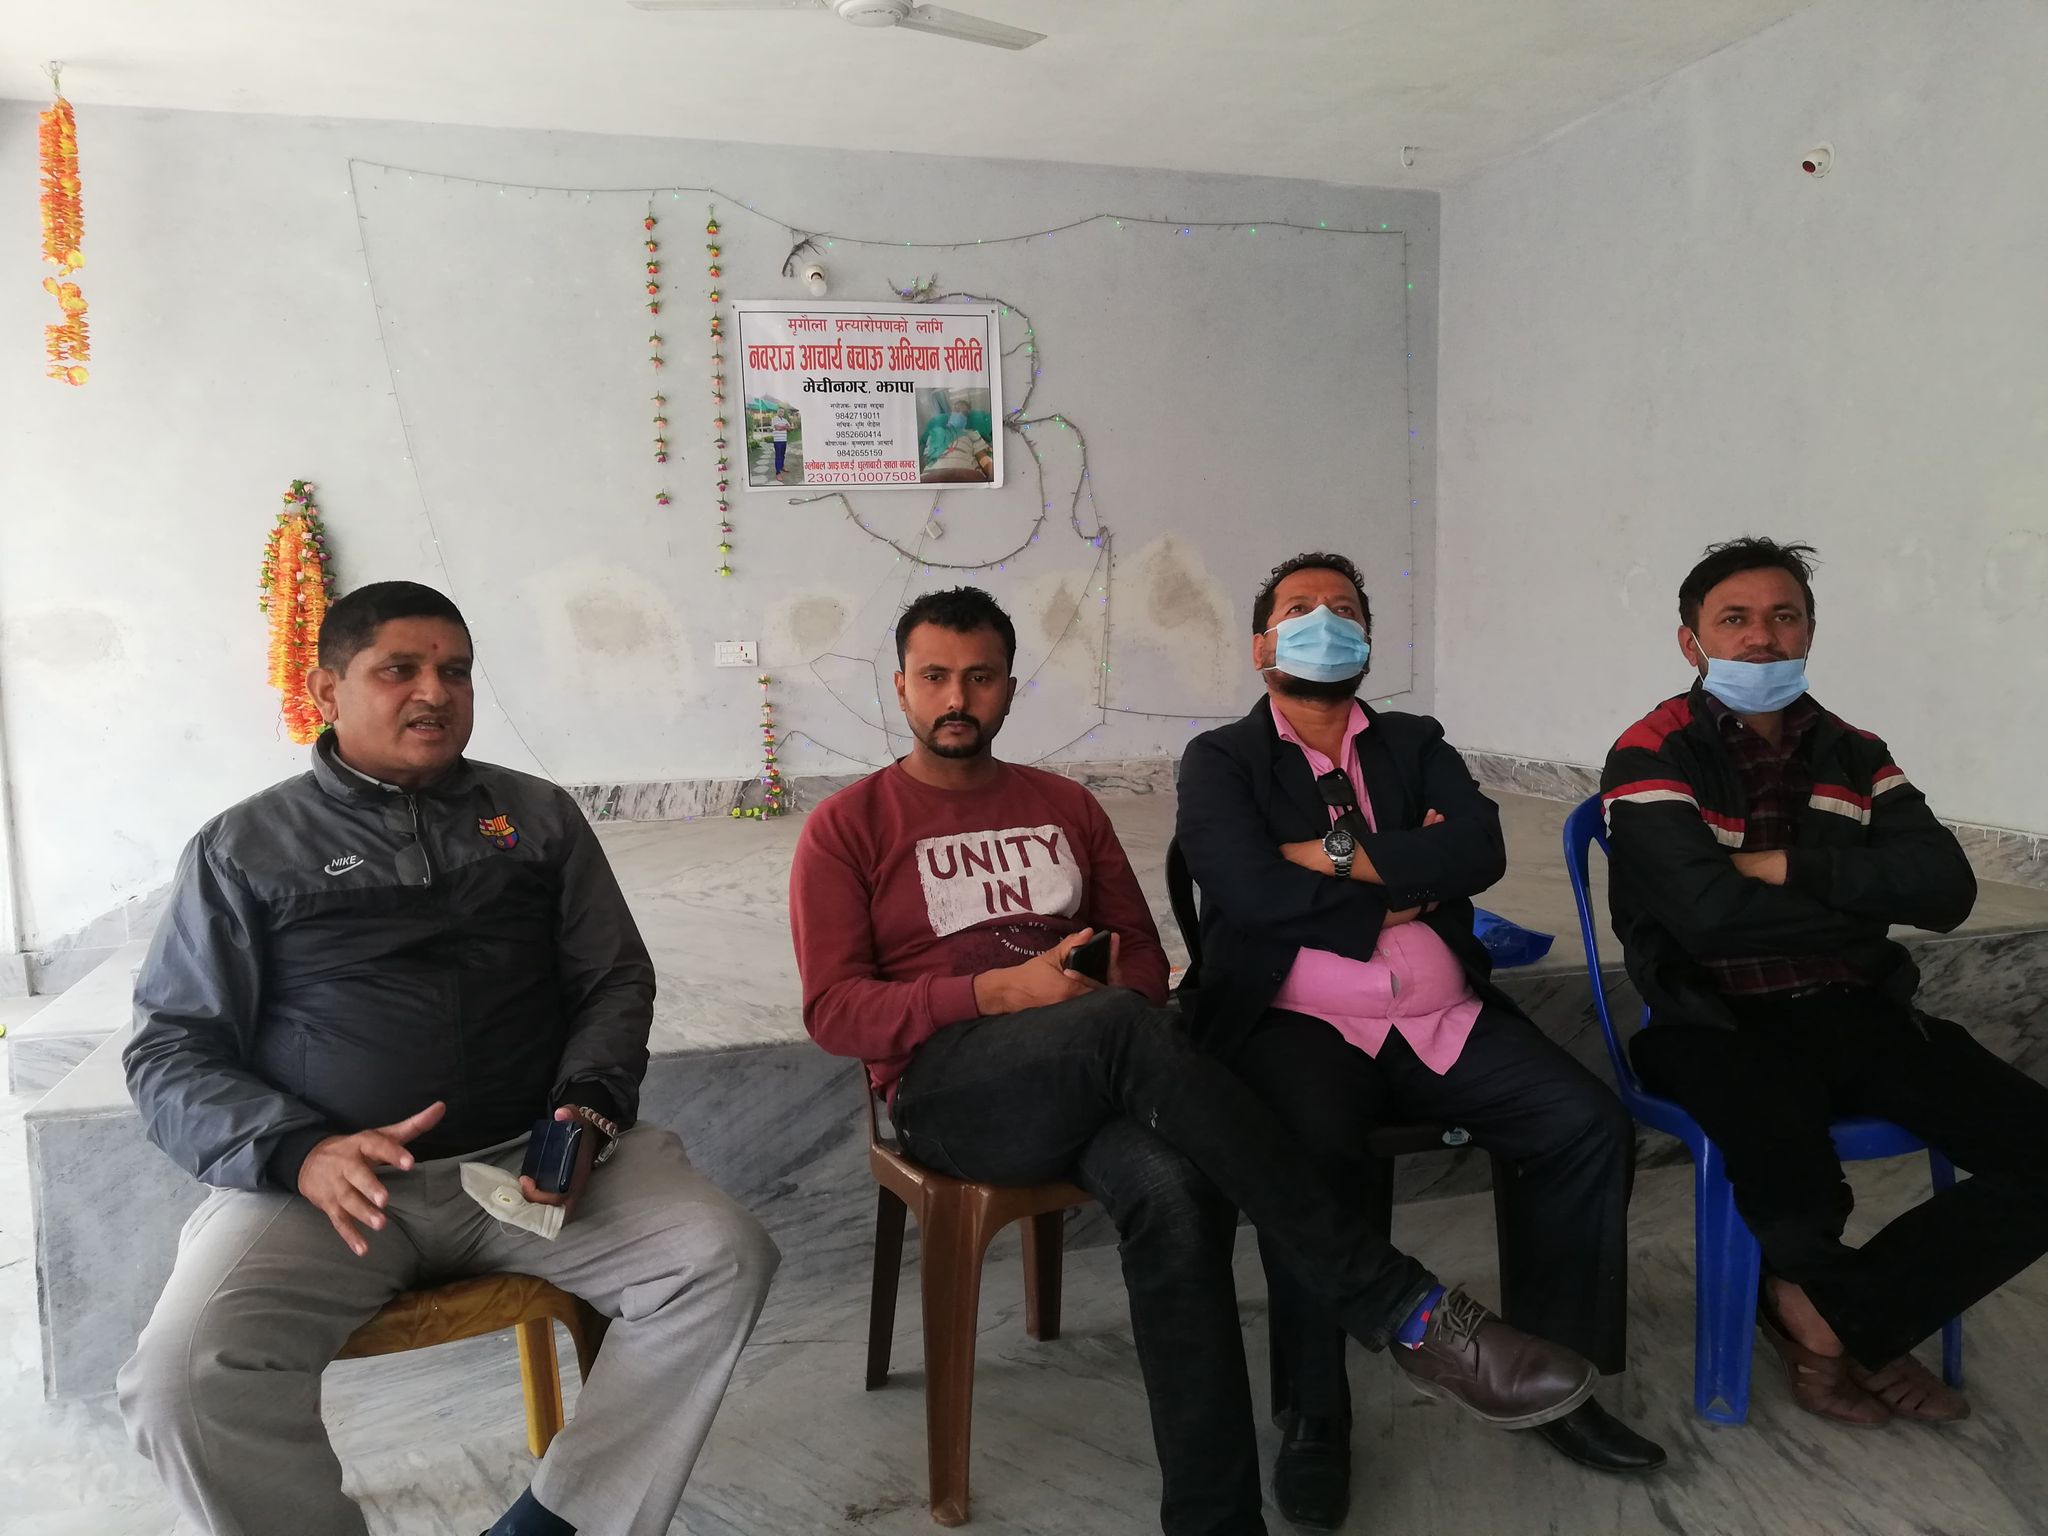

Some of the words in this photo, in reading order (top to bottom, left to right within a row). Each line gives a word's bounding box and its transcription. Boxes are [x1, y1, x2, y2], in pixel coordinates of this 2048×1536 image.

[788, 315, 827, 336] मृगौला
[836, 315, 908, 335] प्रत्यारोपणको
[916, 318, 944, 334] लागि
[748, 344, 795, 372] नवराज
[799, 337, 843, 371] आचार्य
[847, 344, 884, 372] बचाऊ
[887, 336, 940, 372] अभियान
[944, 337, 983, 373] समिति
[876, 380, 915, 394] झापा
[835, 412, 880, 420] 9842719011
[836, 430, 882, 439] 9852660414
[836, 449, 883, 457] 9842655159
[807, 471, 917, 483] 2307010007508
[331, 854, 358, 867] NIKE
[926, 832, 1060, 880] UNITY
[982, 875, 1034, 915] IN
[1000, 938, 1035, 956] PREMIUM
